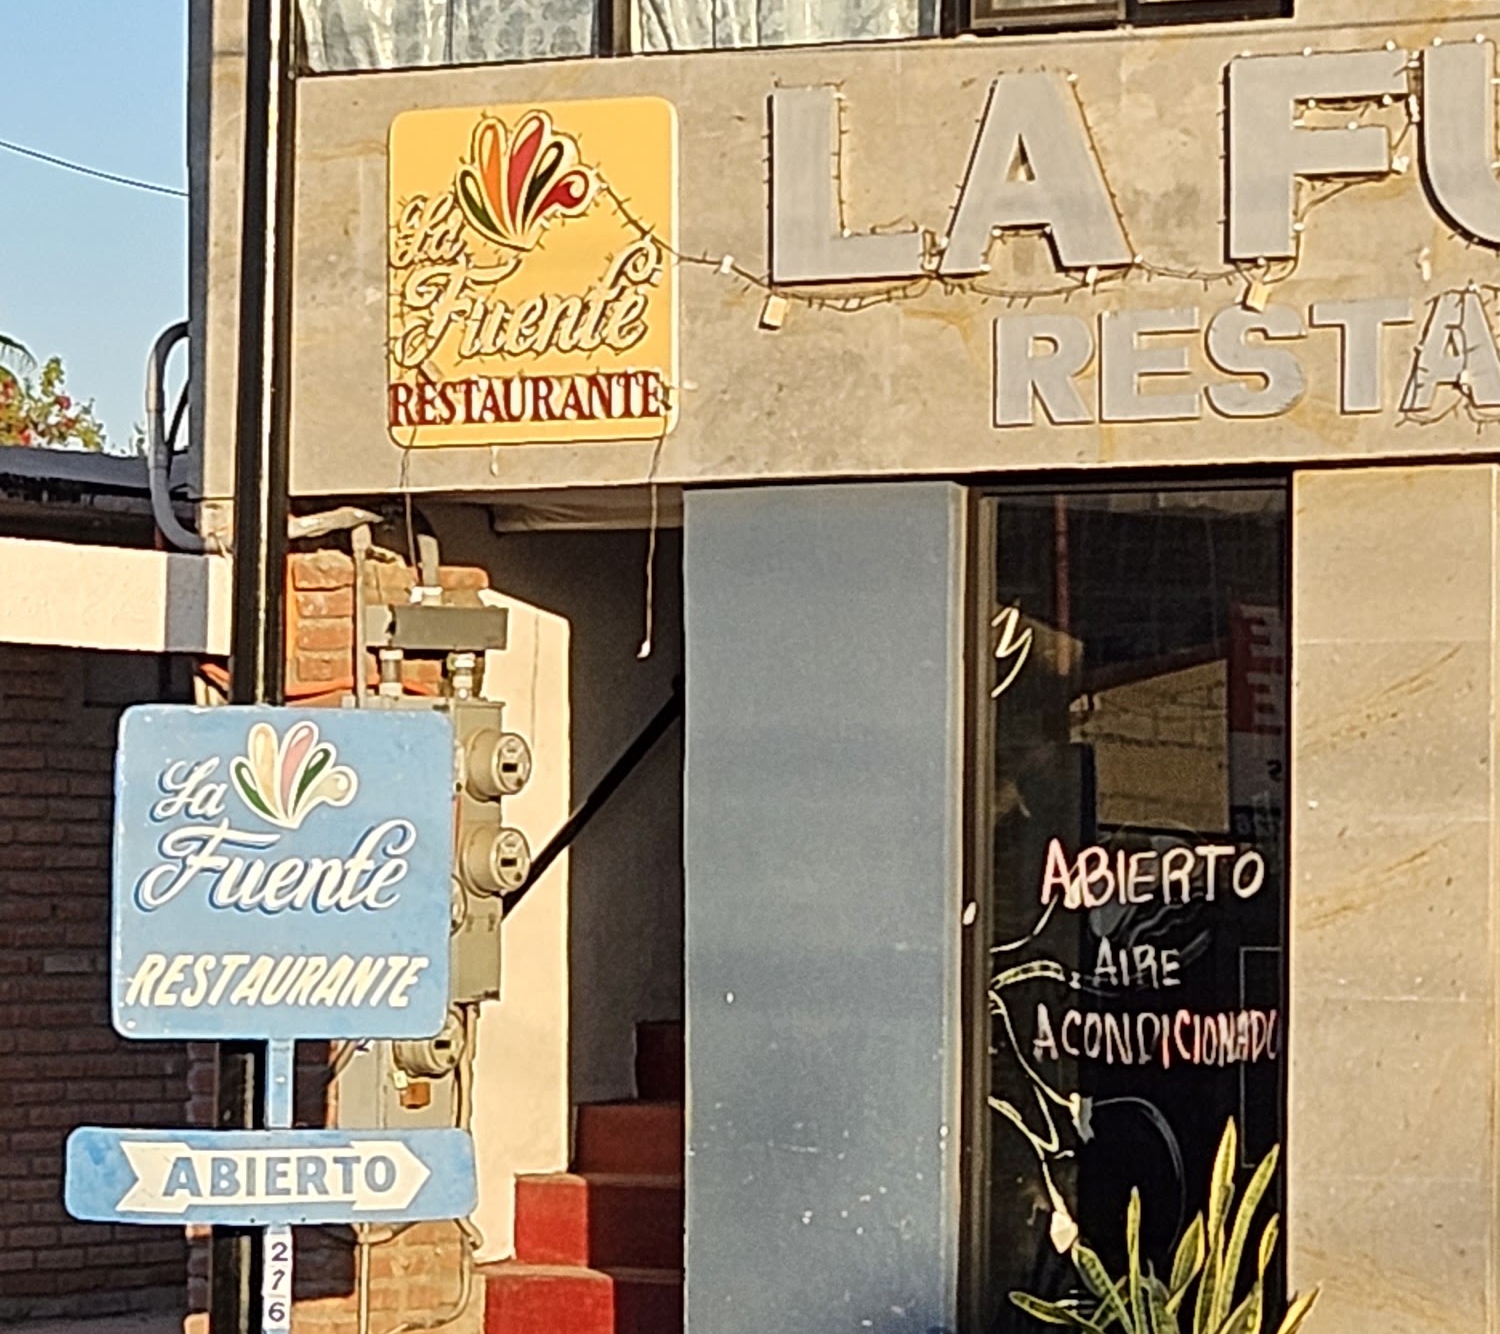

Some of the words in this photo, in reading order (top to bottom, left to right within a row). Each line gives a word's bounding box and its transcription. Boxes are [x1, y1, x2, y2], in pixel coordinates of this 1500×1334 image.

[769, 69, 1134, 283] LA
[392, 195, 467, 268] La
[395, 237, 662, 366] Fuente
[389, 371, 663, 427] RESTAURANTE
[150, 755, 229, 821] La
[134, 817, 417, 914] Fuente
[1041, 839, 1265, 908] ABIERTO
[125, 952, 428, 1008] RESTAURANTE
[1092, 936, 1182, 988] AIRE
[163, 1154, 397, 1201] ABIERTO
